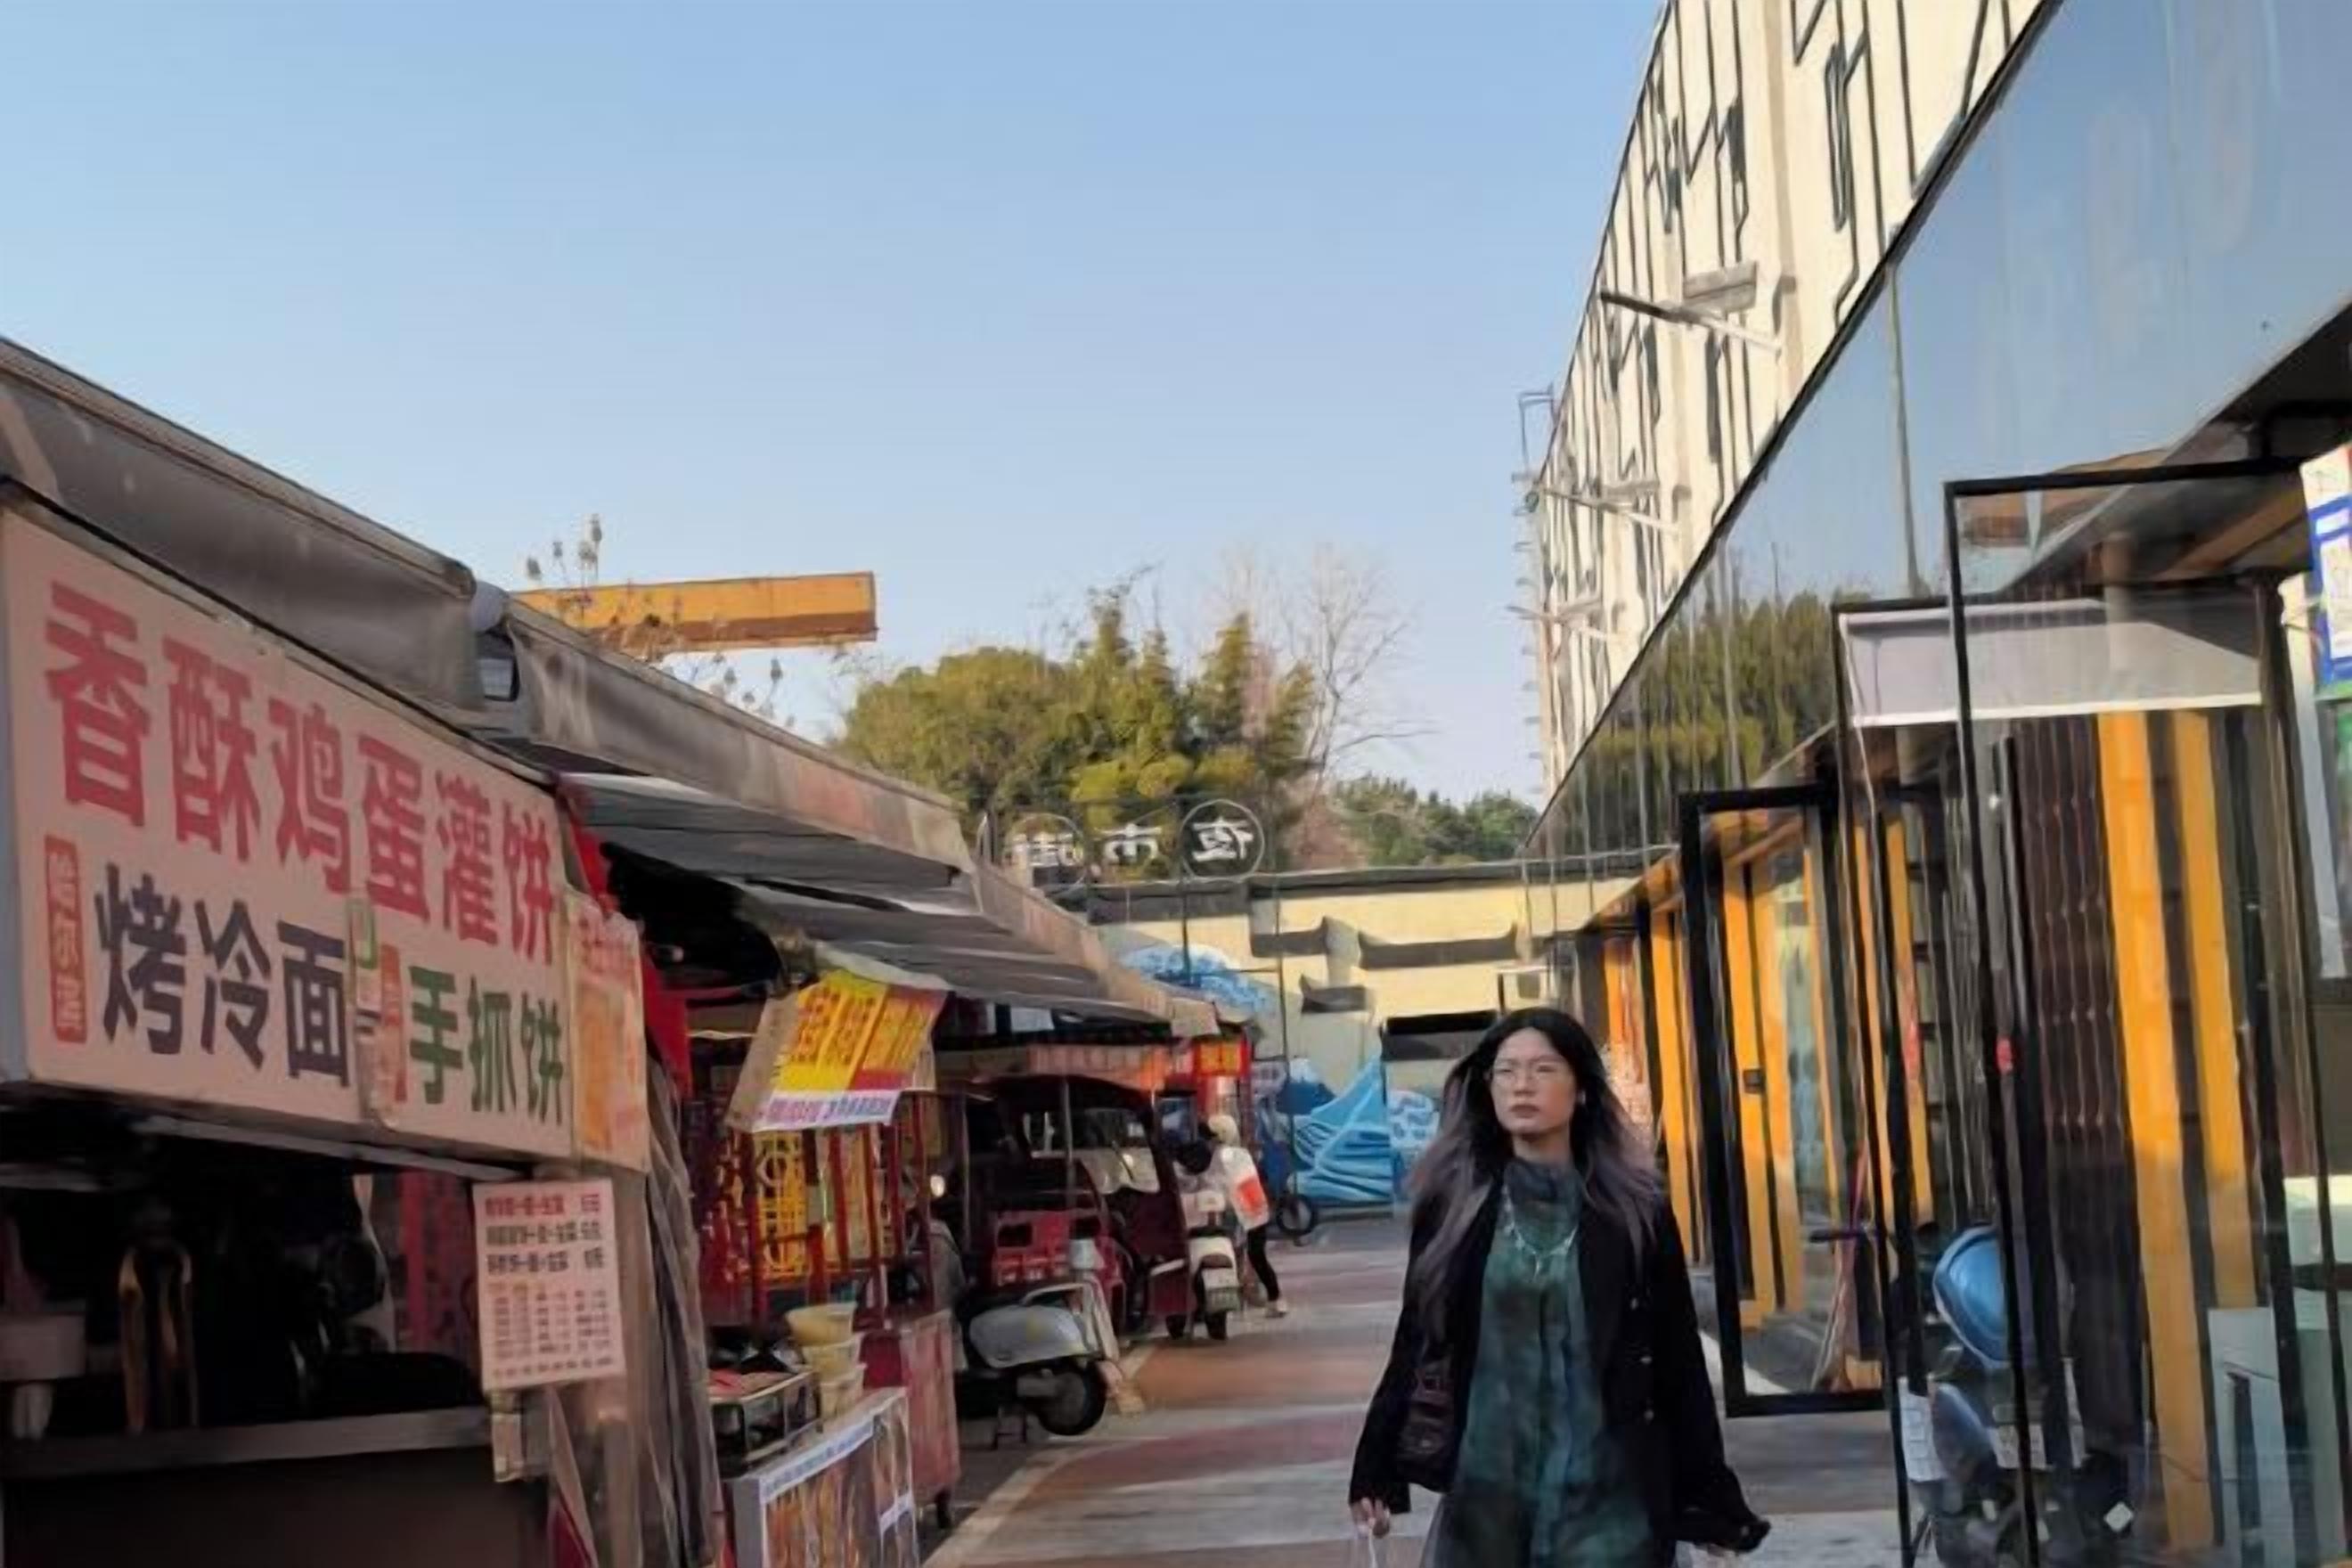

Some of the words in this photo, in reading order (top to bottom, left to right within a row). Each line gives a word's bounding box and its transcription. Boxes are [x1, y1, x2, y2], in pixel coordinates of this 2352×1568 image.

[44, 580, 556, 967] 香酥鸡蛋灌饼
[94, 862, 350, 1089] 烤冷面
[408, 965, 565, 1126] 手抓饼
